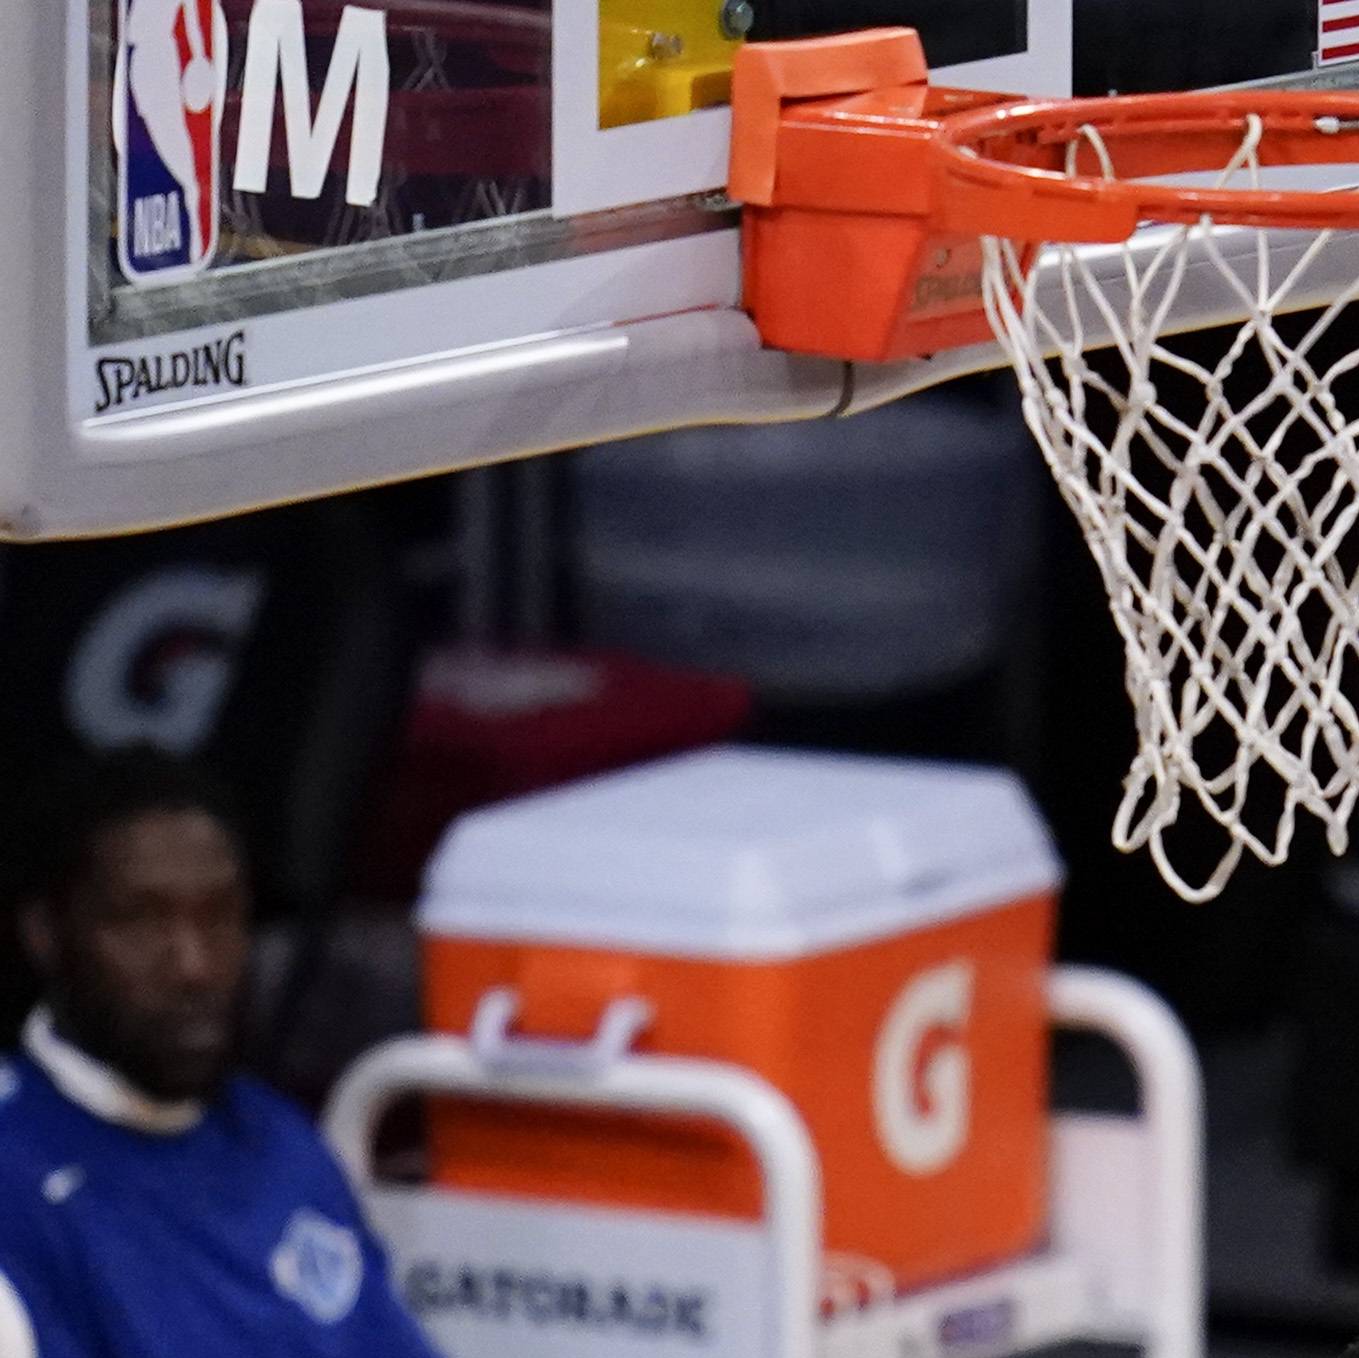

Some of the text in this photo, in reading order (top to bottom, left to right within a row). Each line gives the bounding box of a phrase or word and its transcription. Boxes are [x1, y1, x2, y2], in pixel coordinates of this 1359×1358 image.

[233, 0, 390, 207] M
[133, 191, 182, 257] NBA
[95, 331, 246, 411] SPALDING
[869, 957, 974, 1176] G
